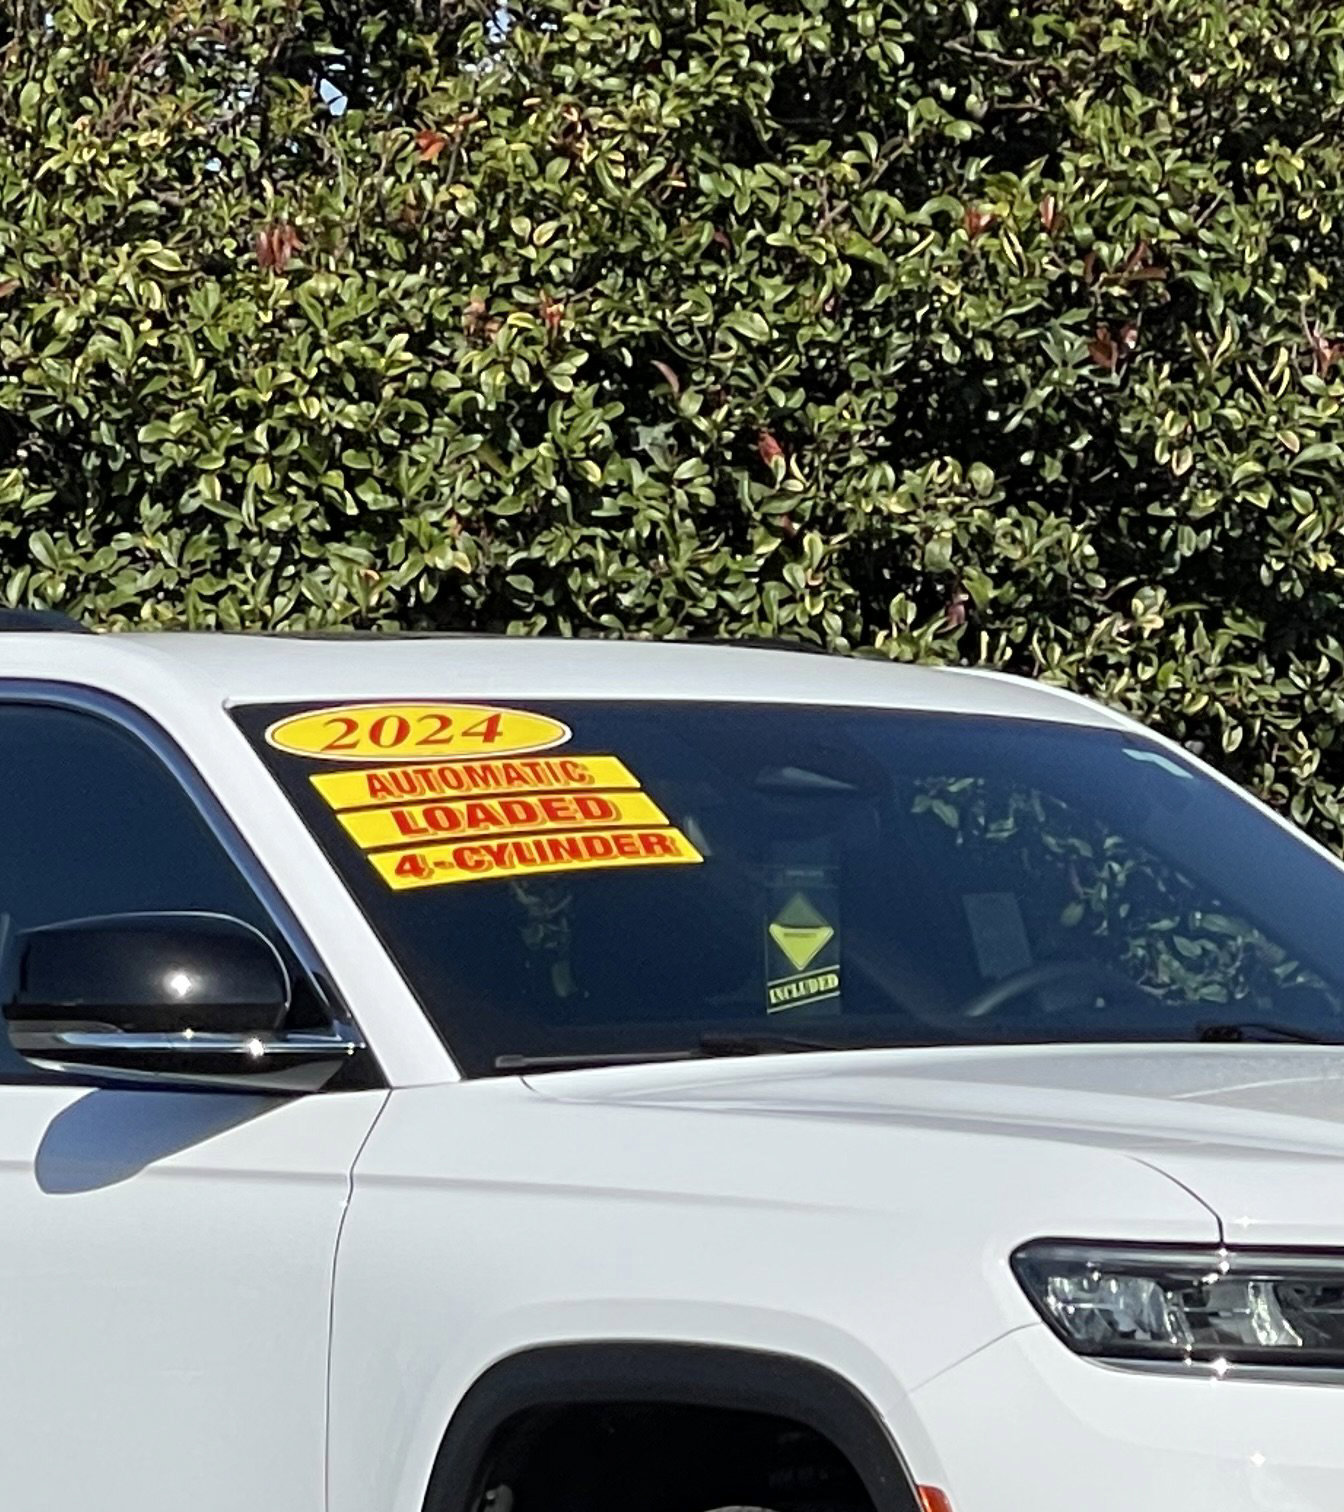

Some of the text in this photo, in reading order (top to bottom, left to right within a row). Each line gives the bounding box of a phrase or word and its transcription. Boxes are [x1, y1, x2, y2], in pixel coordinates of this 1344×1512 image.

[321, 712, 504, 752] 2024
[366, 760, 593, 801] AUTOMATIC
[391, 796, 622, 838] LOADED
[394, 832, 681, 877] 4-CYLINDER
[769, 973, 839, 1004] INCLUDED
